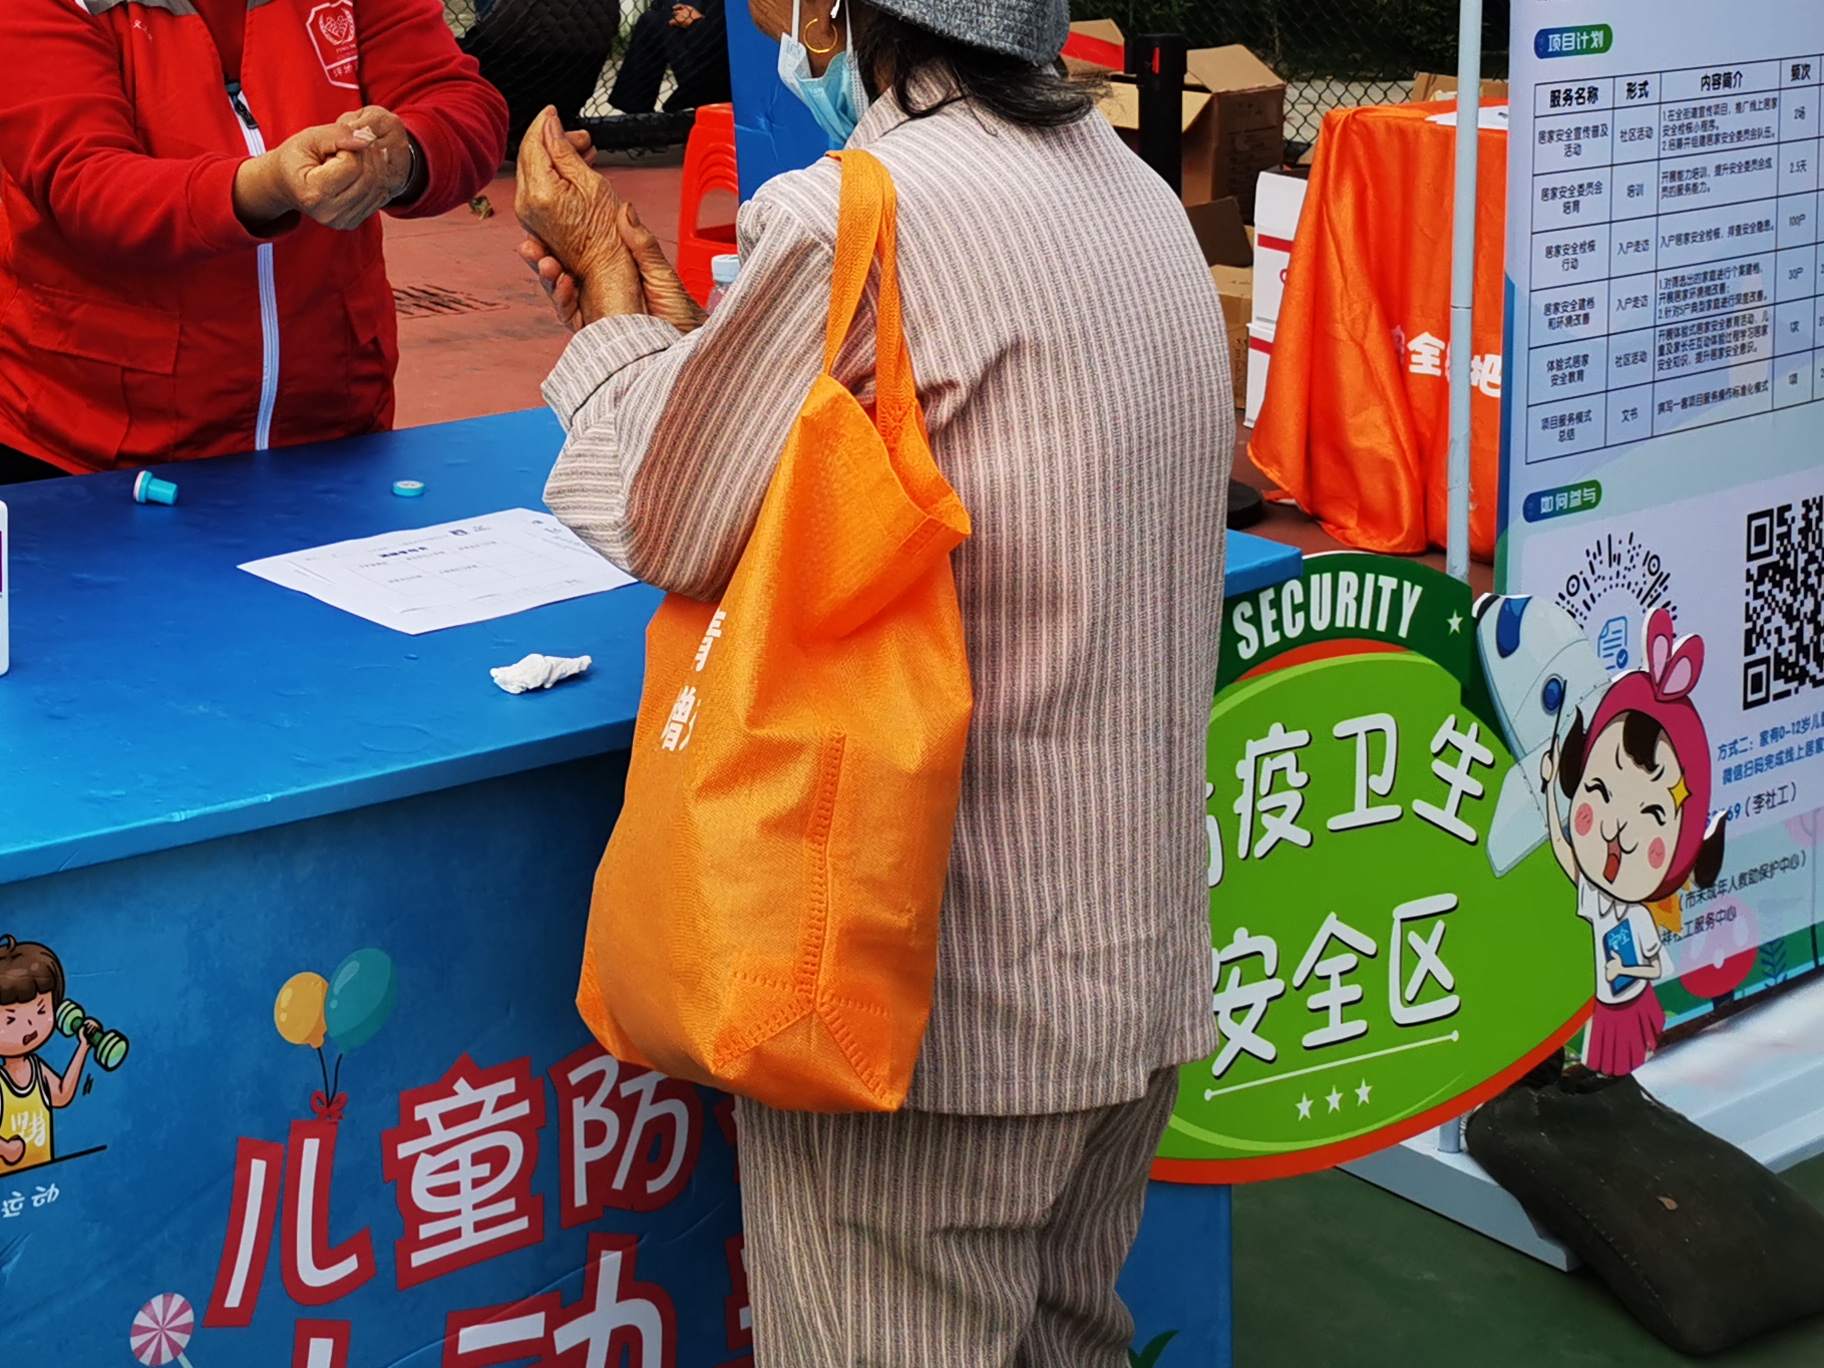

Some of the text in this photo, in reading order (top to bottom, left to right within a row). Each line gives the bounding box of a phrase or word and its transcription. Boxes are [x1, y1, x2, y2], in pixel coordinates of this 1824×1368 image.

[1547, 30, 1604, 52] 项目计划
[1549, 63, 1811, 108] 服务名称 形式 内容简介 频次
[1232, 571, 1423, 660] SECURITY
[1207, 713, 1495, 888] 疫卫生
[1212, 892, 1460, 1078] 安全区
[223, 1052, 692, 1308] 儿童防
